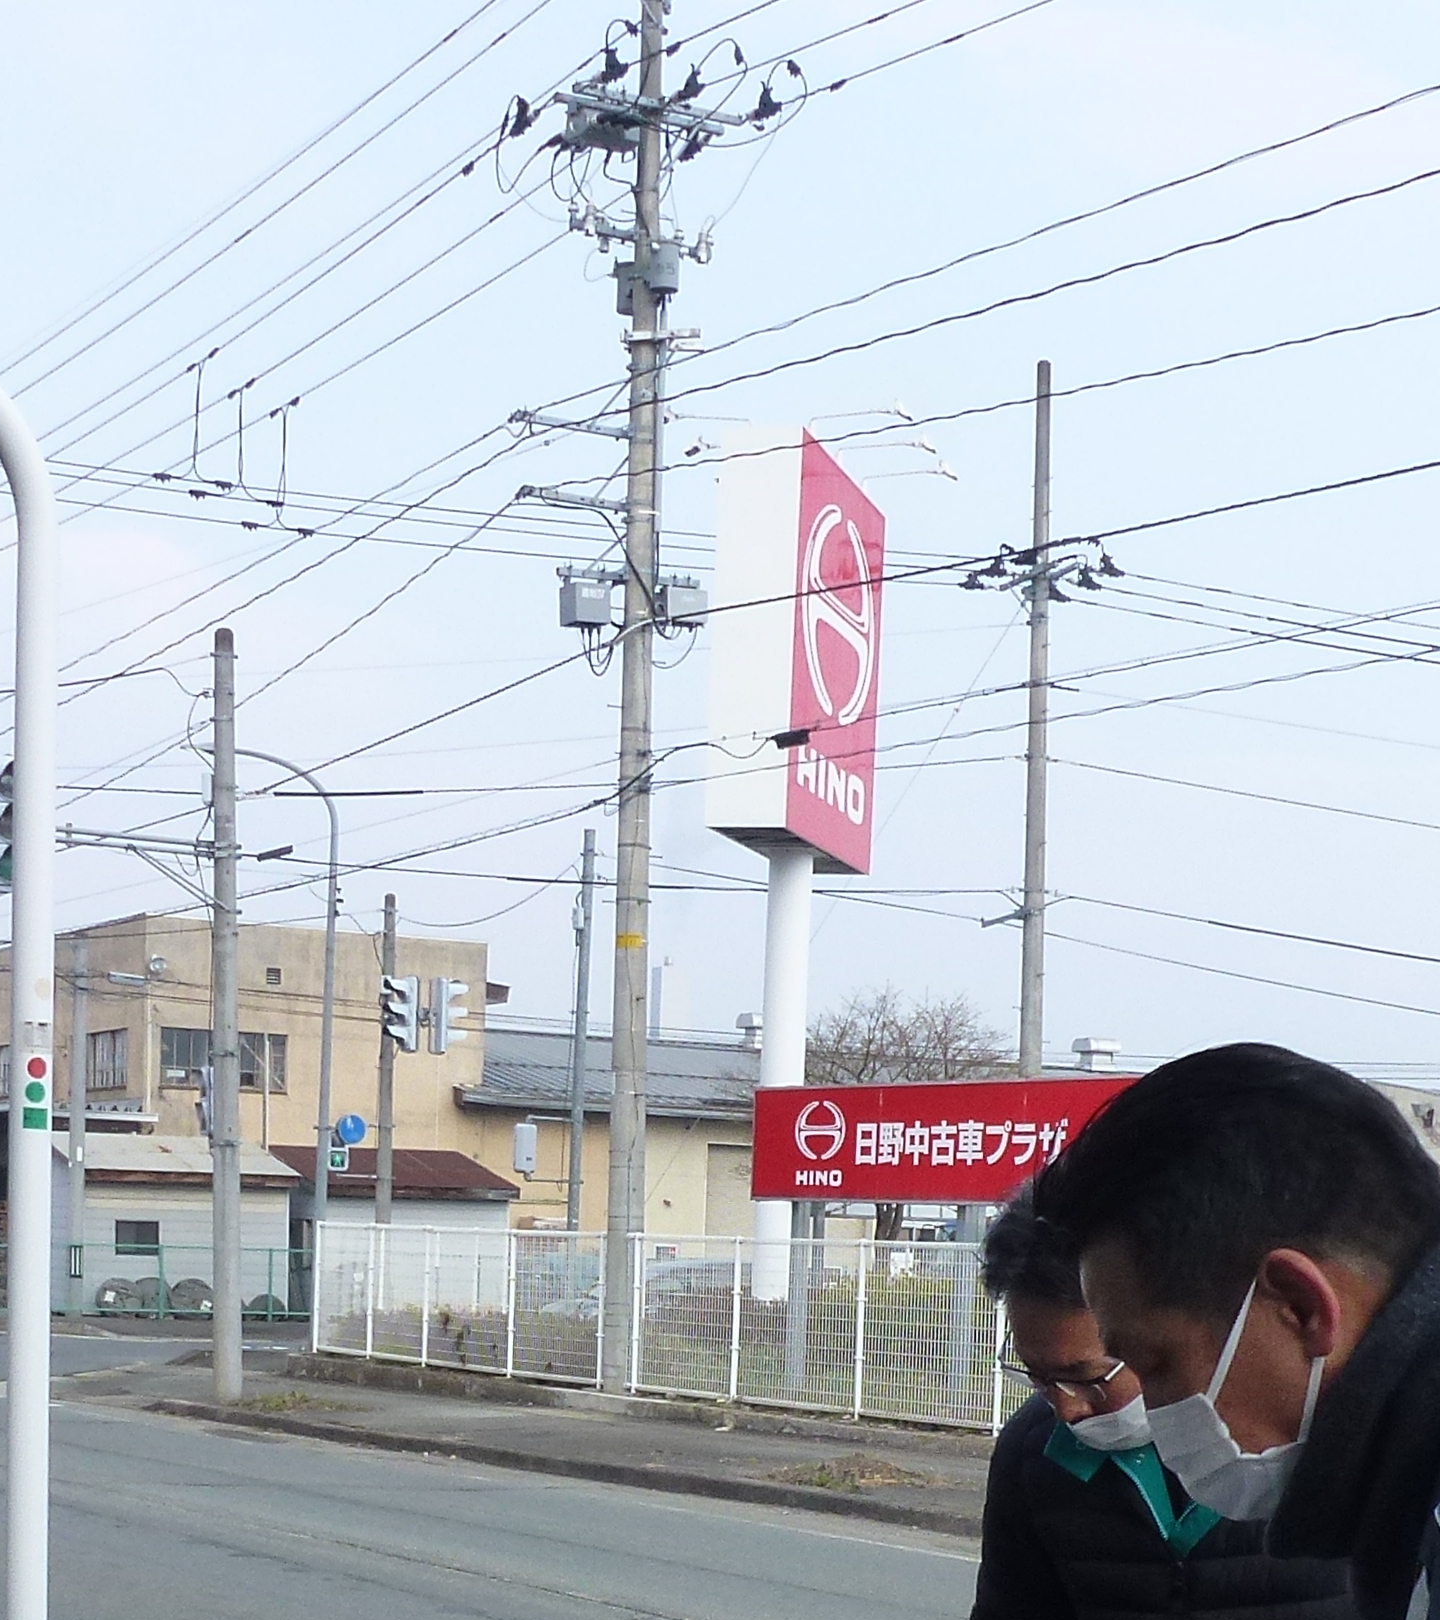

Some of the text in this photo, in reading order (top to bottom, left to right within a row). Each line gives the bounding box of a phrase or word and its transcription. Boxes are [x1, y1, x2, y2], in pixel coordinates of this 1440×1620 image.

[797, 745, 865, 825] HINO
[855, 1118, 1069, 1166] 日野中古車プラザ
[795, 1170, 843, 1187] HINO
